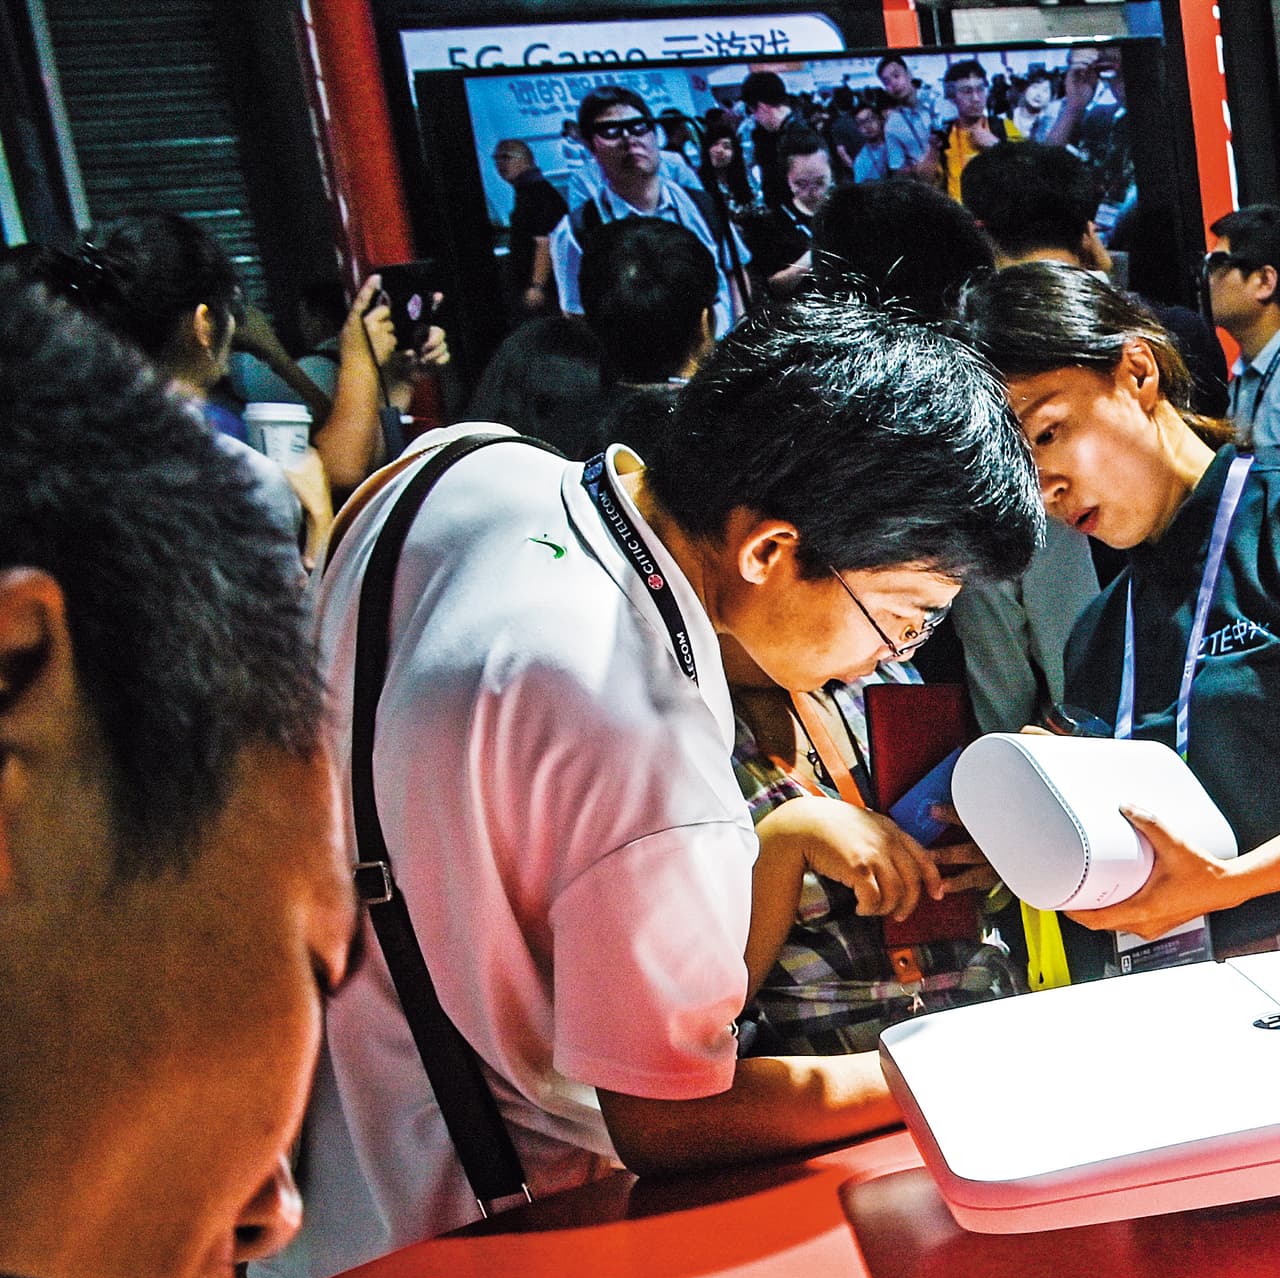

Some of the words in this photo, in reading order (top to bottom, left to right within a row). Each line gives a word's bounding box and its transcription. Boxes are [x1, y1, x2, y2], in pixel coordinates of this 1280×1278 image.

[599, 492, 632, 539] TELECOM
[628, 536, 654, 574] CITIC
[676, 631, 698, 682] LECOM
